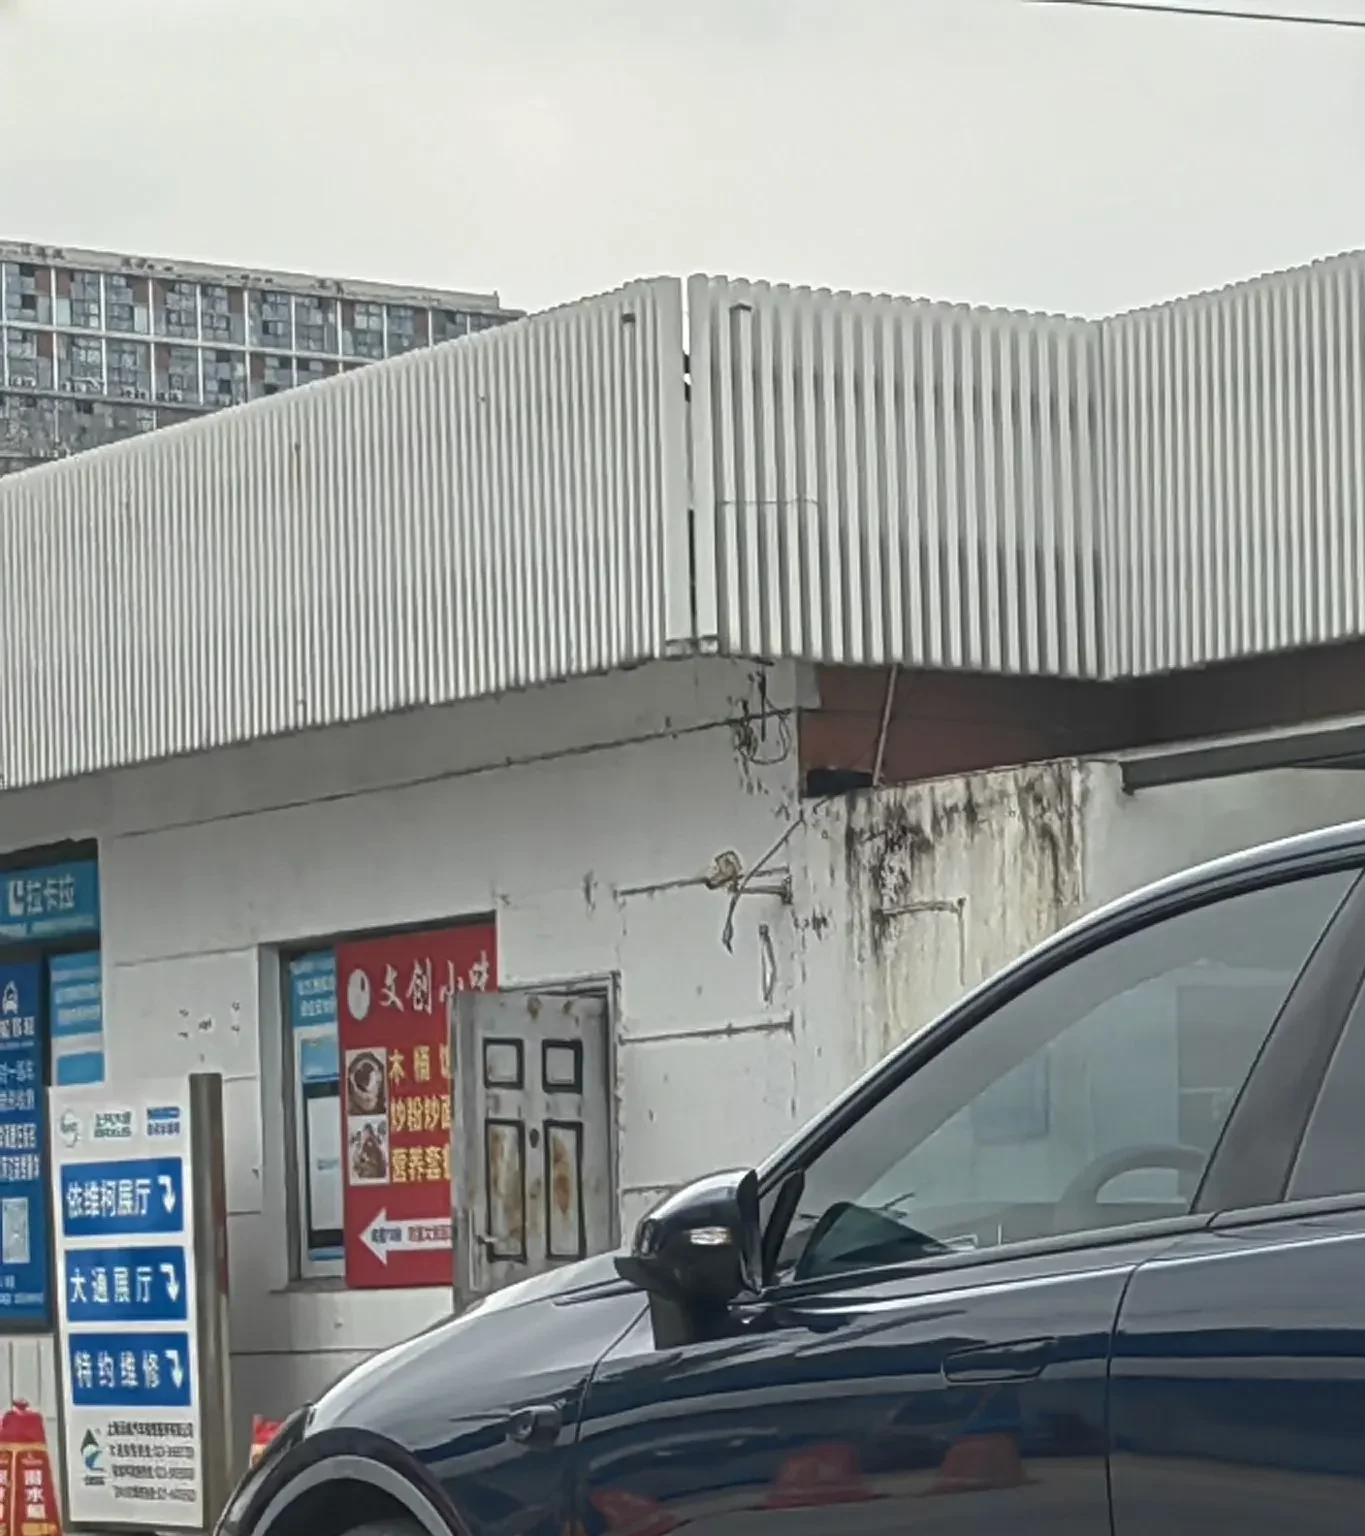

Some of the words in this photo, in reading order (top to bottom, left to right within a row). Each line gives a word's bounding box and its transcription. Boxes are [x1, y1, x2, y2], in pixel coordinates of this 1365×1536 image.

[66, 1178, 152, 1219] 依维柯展厅
[69, 1265, 154, 1304] 大通展厅
[74, 1350, 161, 1389] 特约维修
